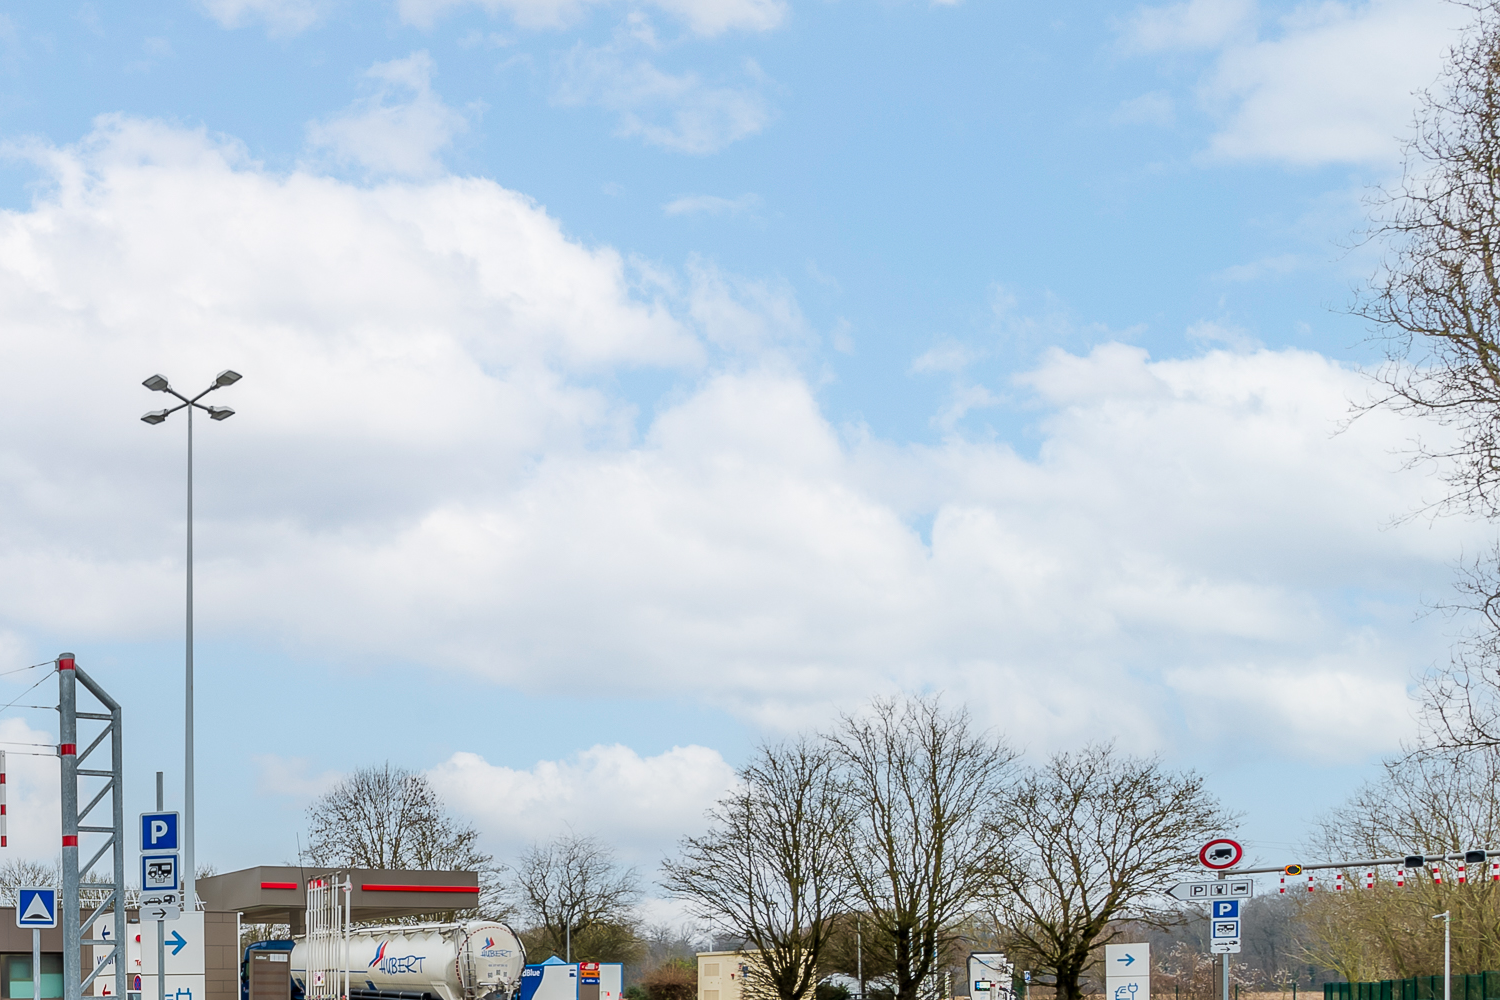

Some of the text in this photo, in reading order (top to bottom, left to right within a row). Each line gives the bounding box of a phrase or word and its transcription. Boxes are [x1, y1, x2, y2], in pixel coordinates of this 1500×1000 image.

[151, 820, 168, 844] P
[1194, 887, 1204, 895] P
[1219, 903, 1232, 915] P
[481, 949, 512, 957] HUBERT
[379, 955, 426, 975] HUBERT
[522, 969, 540, 977] dBlue
